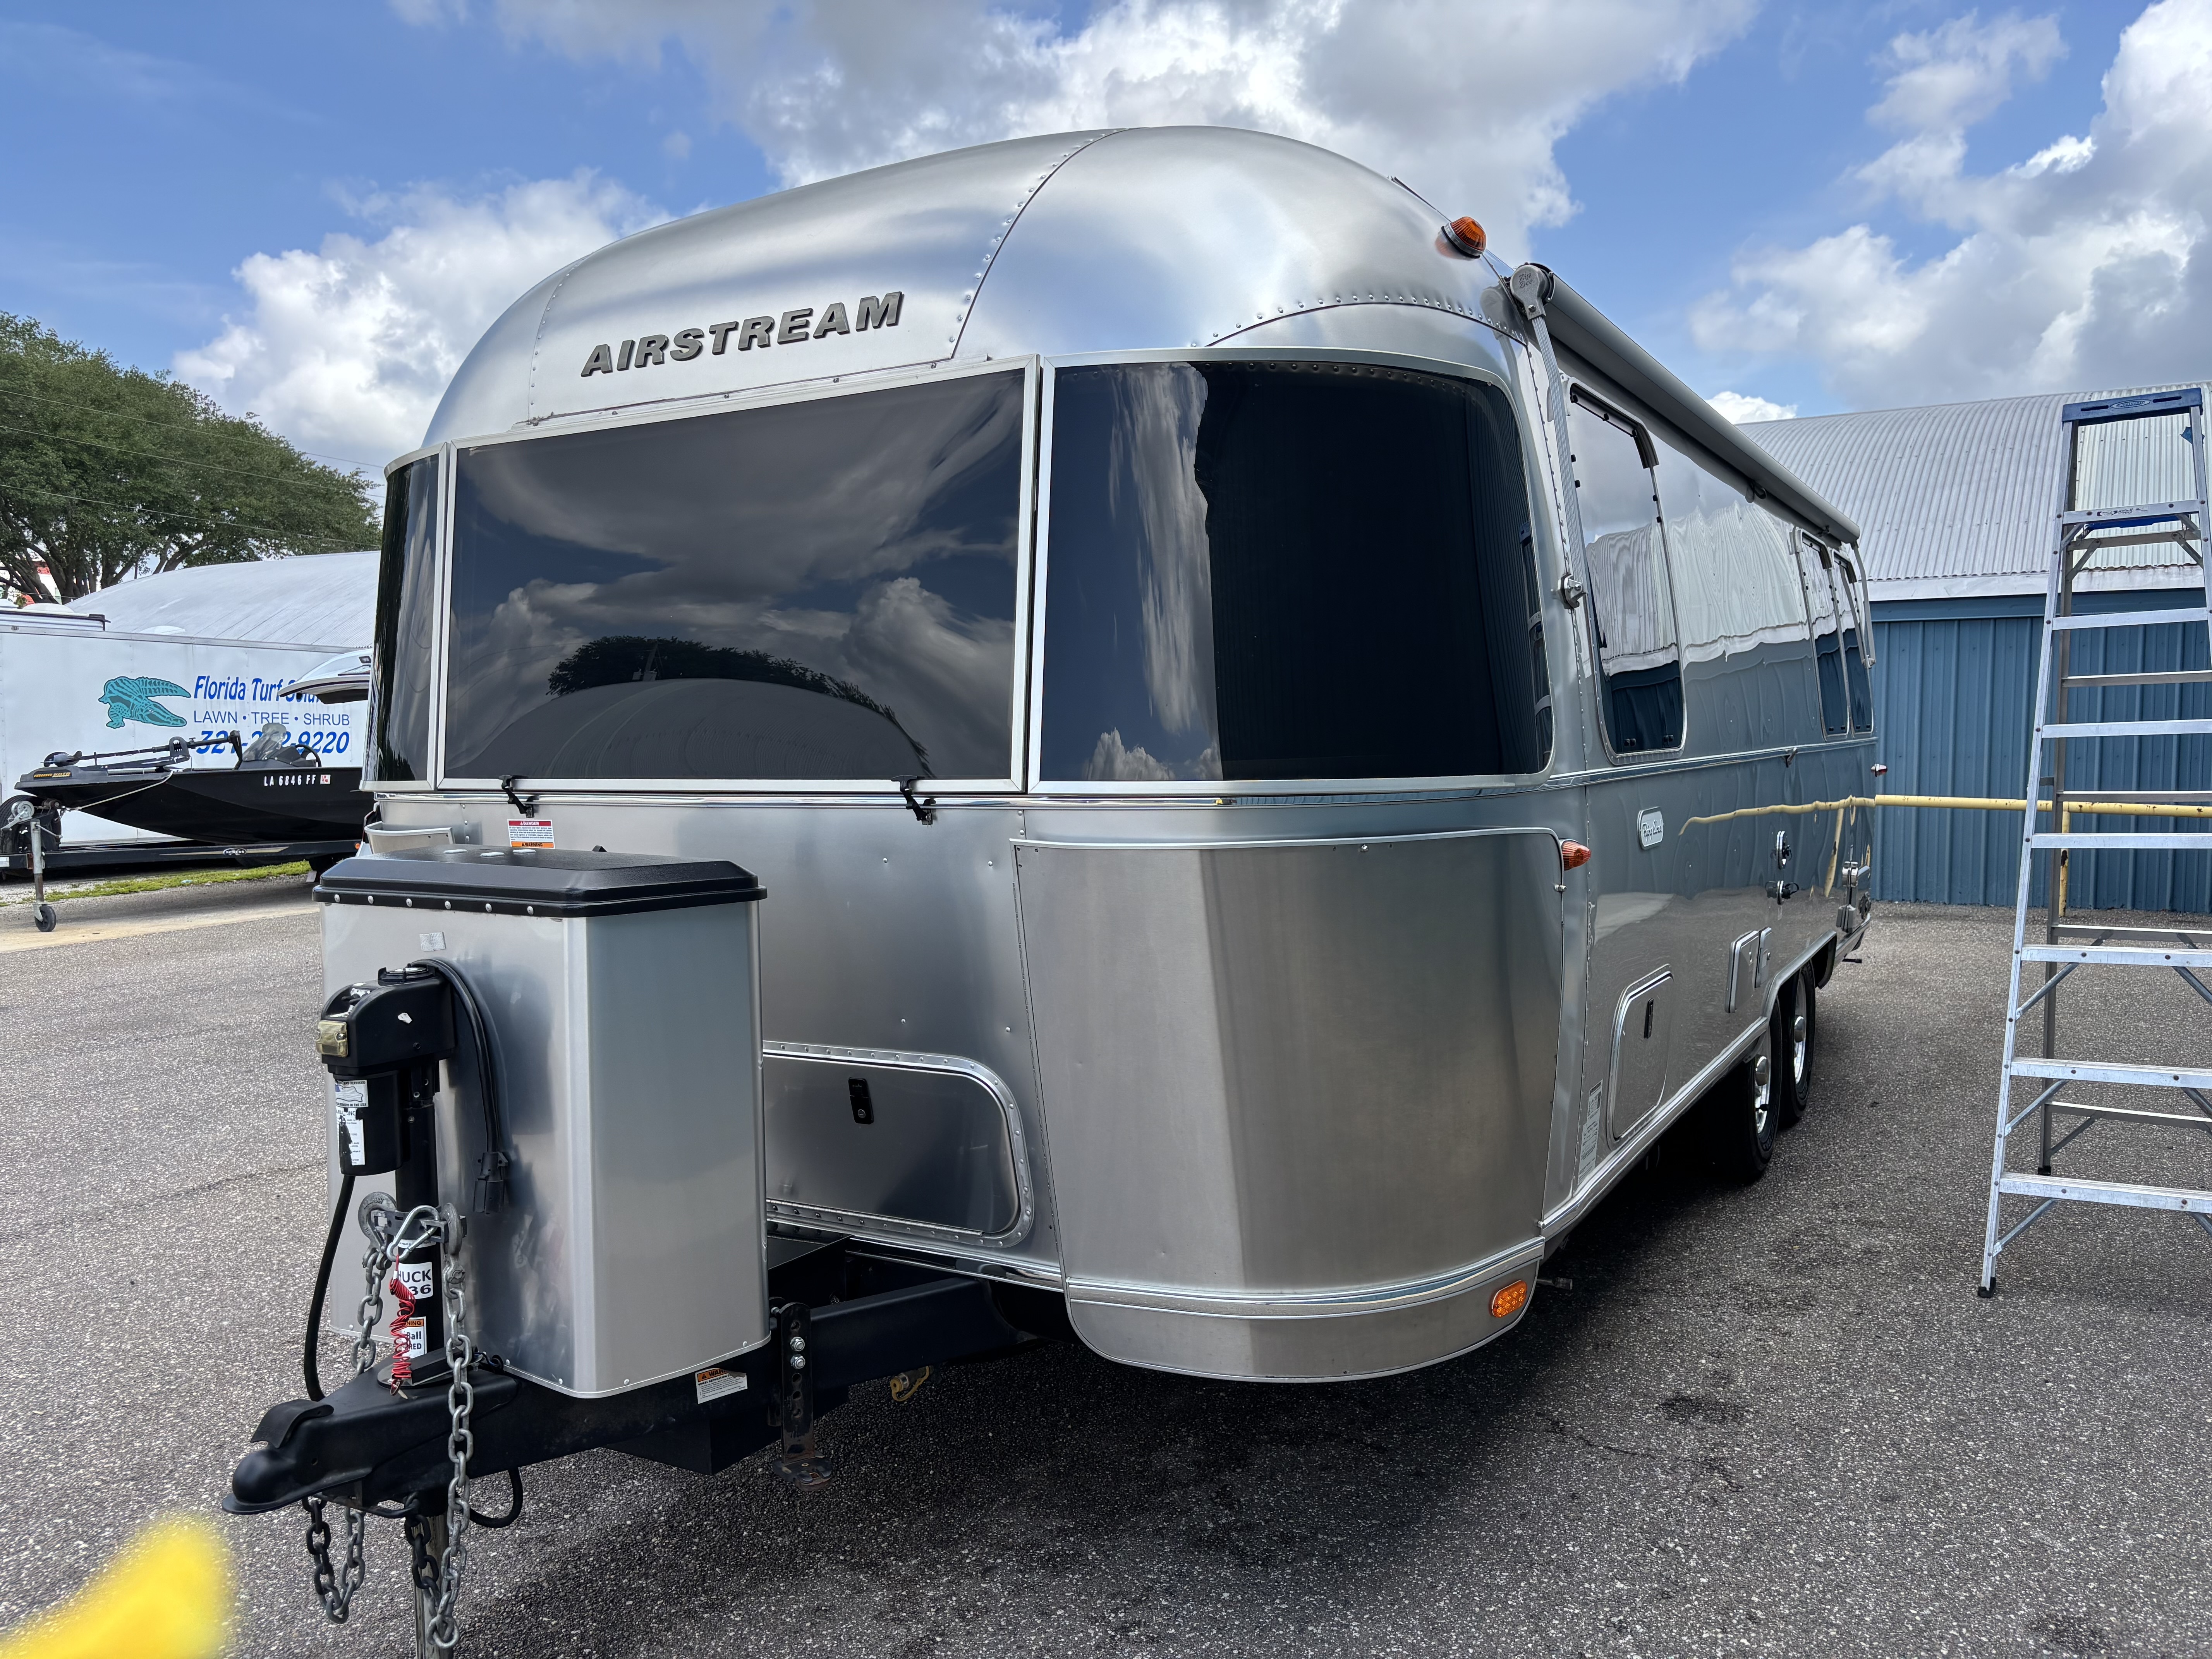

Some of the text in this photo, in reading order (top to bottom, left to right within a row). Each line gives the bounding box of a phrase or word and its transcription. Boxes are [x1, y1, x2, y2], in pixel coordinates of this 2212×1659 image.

[580, 291, 905, 378] AIRSTREAM
[194, 675, 246, 701] Florida
[251, 678, 283, 702] Turf
[194, 710, 349, 726] LAWN TREE SHRUB
[264, 775, 316, 786] LA 6846 FF
